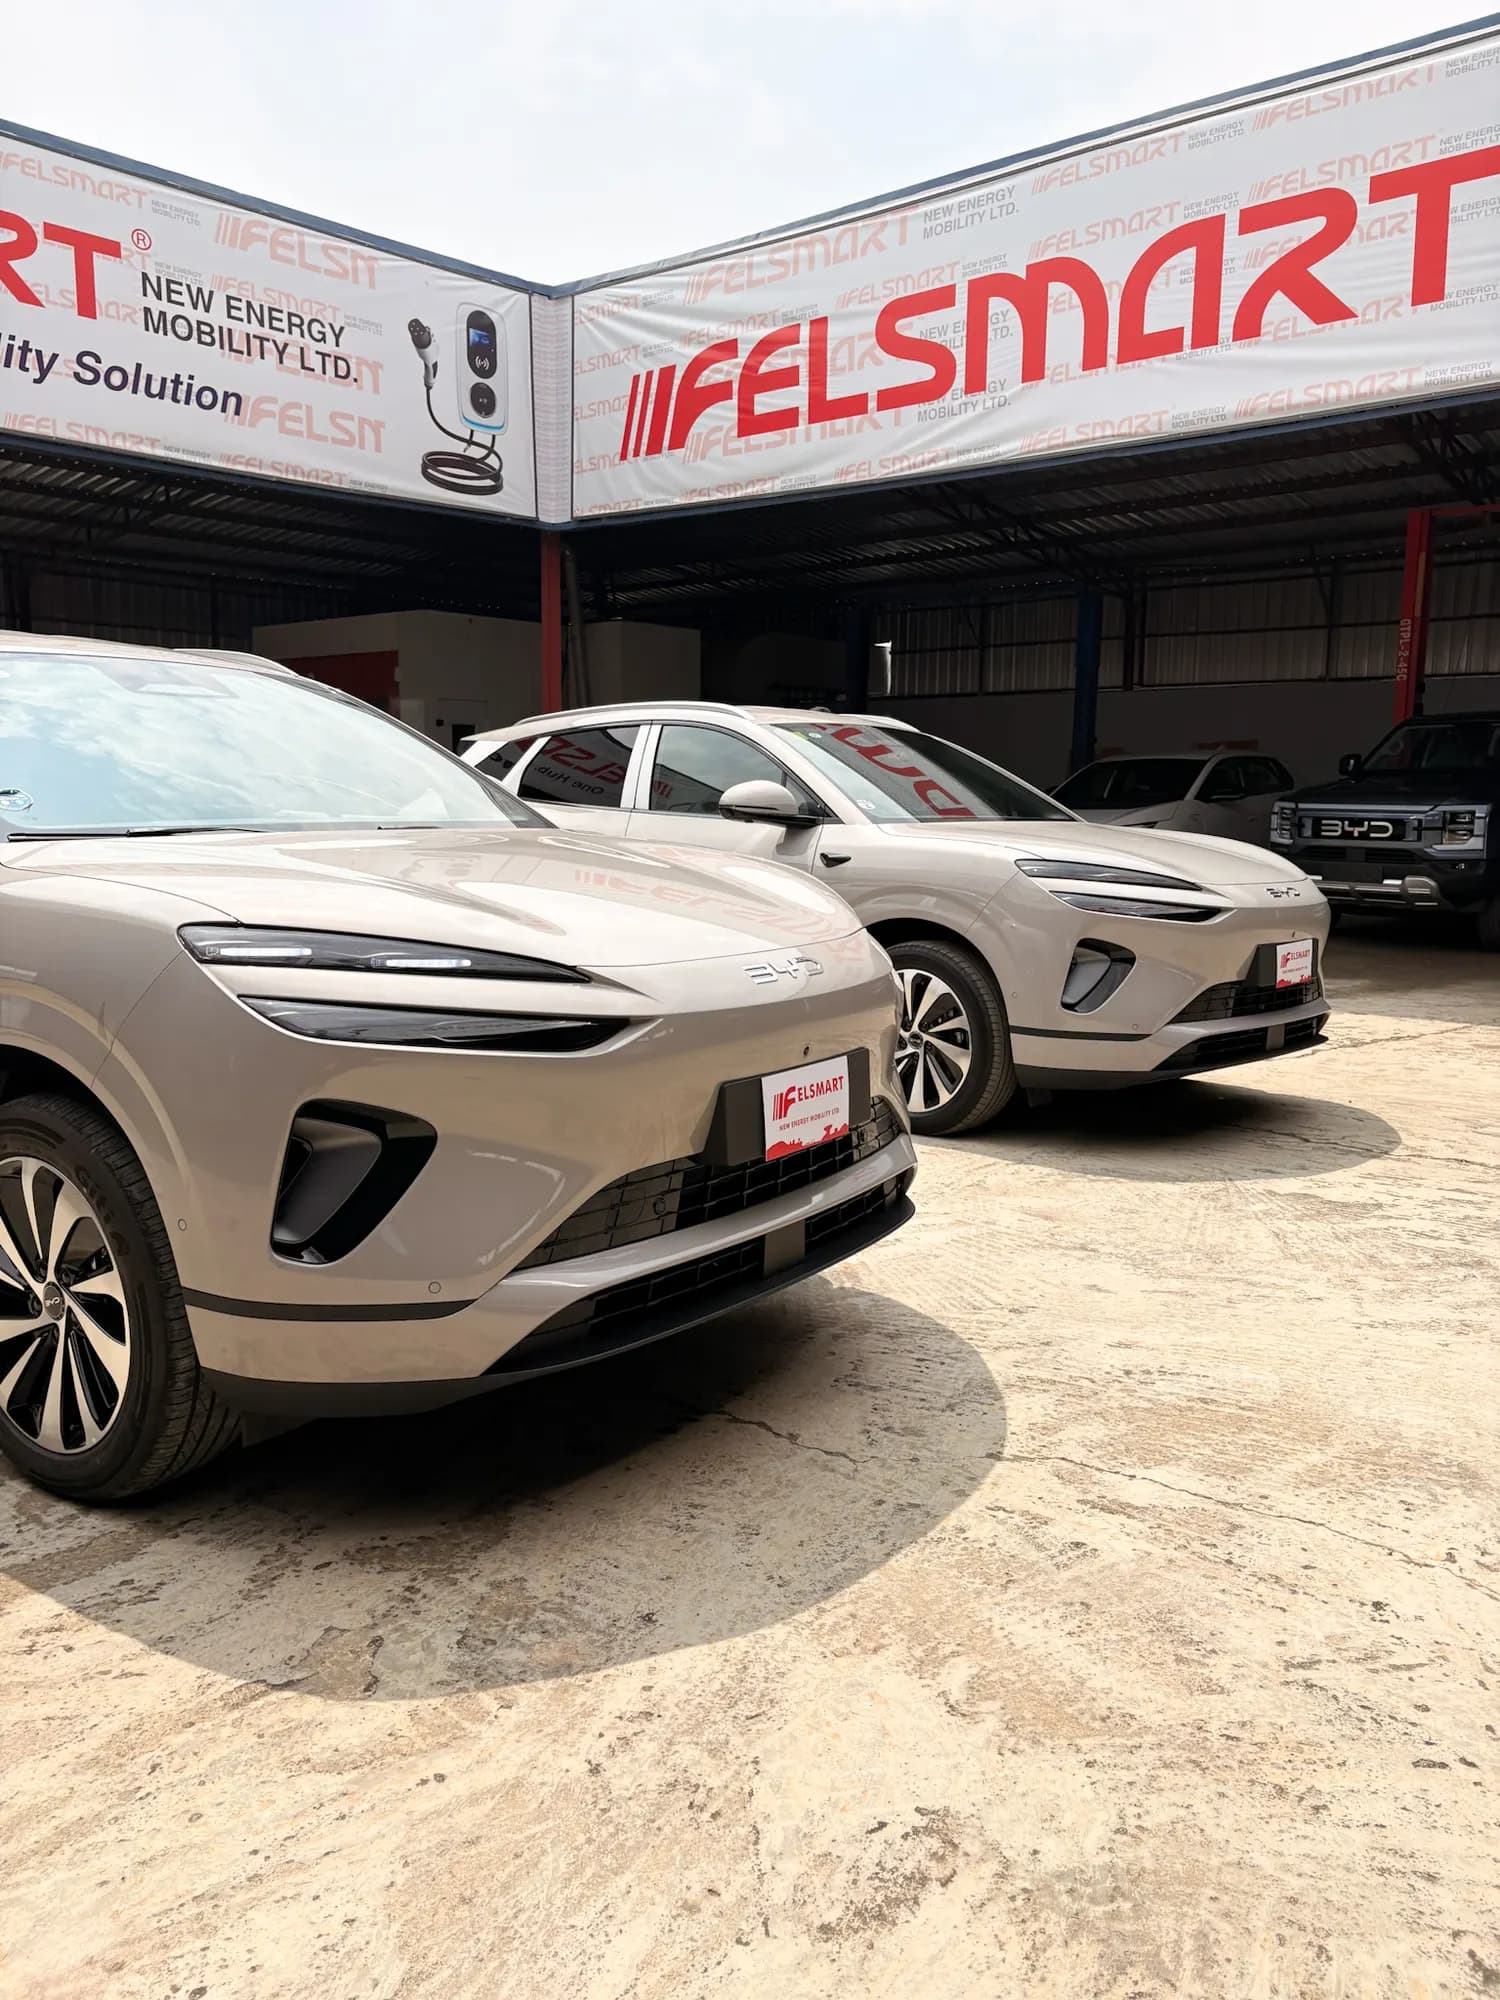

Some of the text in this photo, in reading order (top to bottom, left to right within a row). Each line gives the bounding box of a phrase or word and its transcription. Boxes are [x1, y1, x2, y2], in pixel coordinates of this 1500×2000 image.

[923, 185, 1016, 224] NEW ENERGY
[923, 201, 1019, 240] MOBILITY LTD.
[141, 272, 214, 314] NEW
[225, 294, 345, 348] ENERGY
[666, 144, 1500, 452] FELSMART
[143, 306, 289, 365] MOBILITY
[300, 346, 359, 384] LTD.
[73, 350, 243, 417] Solution
[917, 400, 979, 423] MOBILITY
[983, 395, 1012, 410] LTD.
[1320, 820, 1394, 838] BYD
[780, 1075, 845, 1119] FELSMART
